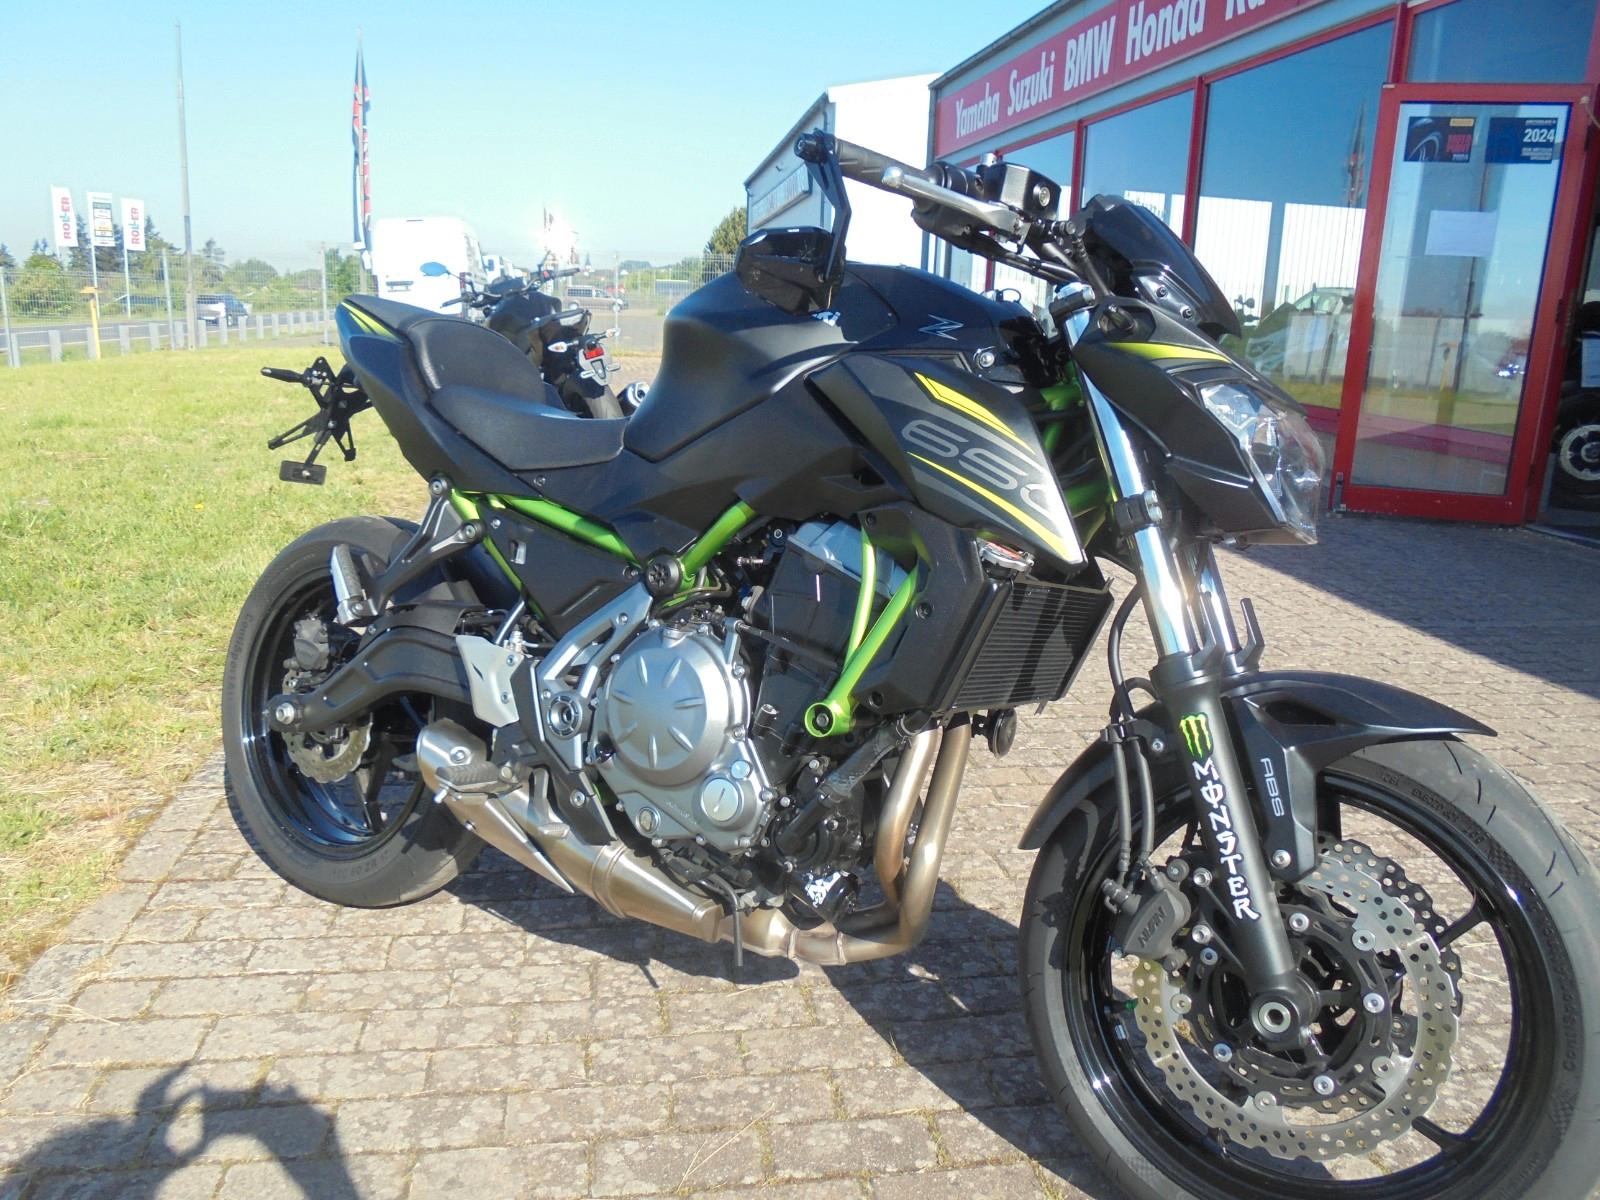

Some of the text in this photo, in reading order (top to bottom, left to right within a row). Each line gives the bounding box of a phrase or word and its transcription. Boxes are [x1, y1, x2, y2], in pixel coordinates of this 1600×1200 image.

[955, 0, 1206, 139] Yamaha Suzuki BMW Honda
[1522, 128, 1555, 143] 2024
[1260, 756, 1286, 818] ABS
